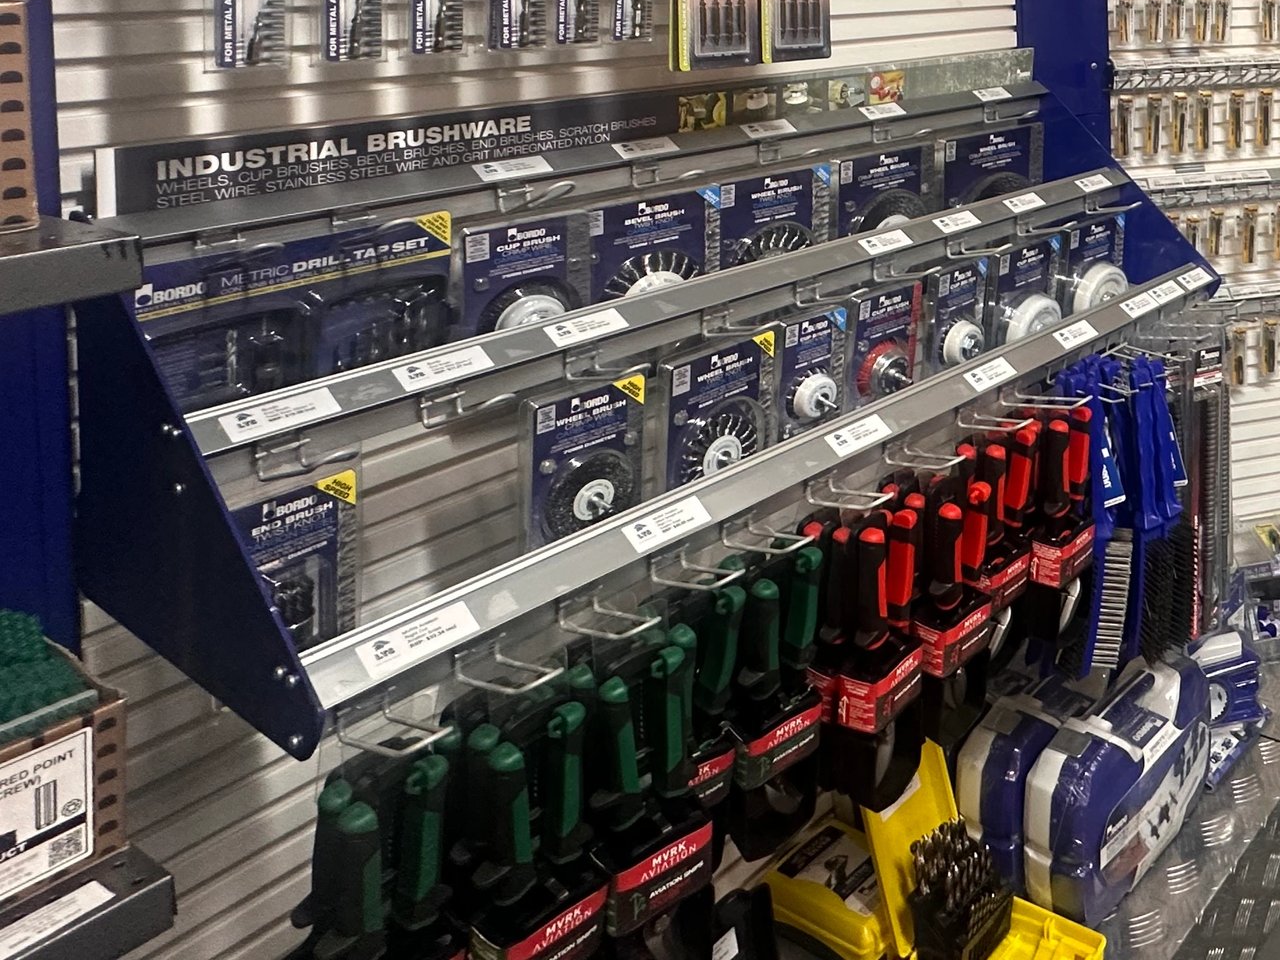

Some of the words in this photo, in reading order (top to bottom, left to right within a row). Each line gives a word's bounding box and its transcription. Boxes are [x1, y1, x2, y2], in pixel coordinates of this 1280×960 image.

[224, 8, 233, 39] METAL
[224, 42, 233, 62] FOR
[156, 137, 357, 181] INDUSTRIAL
[367, 116, 532, 152] BRUSHWARE
[239, 168, 274, 183] CUP
[357, 151, 401, 168] BEVEL
[472, 138, 497, 151] END
[559, 123, 608, 140] SCRATCH
[611, 116, 657, 132] BRUSHES
[156, 191, 210, 209] STEEL
[265, 170, 347, 193] STAINLESS
[349, 164, 392, 180] STEEL
[396, 159, 429, 173] WIRE
[432, 154, 460, 168] AND
[462, 149, 491, 162] GRIT
[493, 139, 572, 158] IMPREGNATED
[575, 133, 610, 146] NYLON
[496, 242, 521, 252] CUP
[221, 264, 289, 288] METRIC
[292, 255, 348, 272] DRILL
[353, 245, 390, 259] TAP
[392, 237, 429, 252] SET
[323, 484, 350, 499] SPEED
[332, 478, 352, 492] HIGH
[251, 520, 281, 536] END
[284, 501, 333, 524] BRUSH
[276, 495, 317, 515] BORDO
[767, 719, 811, 750] AVIATION
[776, 717, 803, 737] MVRK
[33, 748, 75, 774] POINT
[640, 843, 697, 883] AVIATION
[652, 840, 686, 867] MVRK
[532, 907, 592, 955] AVIATION
[546, 907, 582, 937] MVRK
